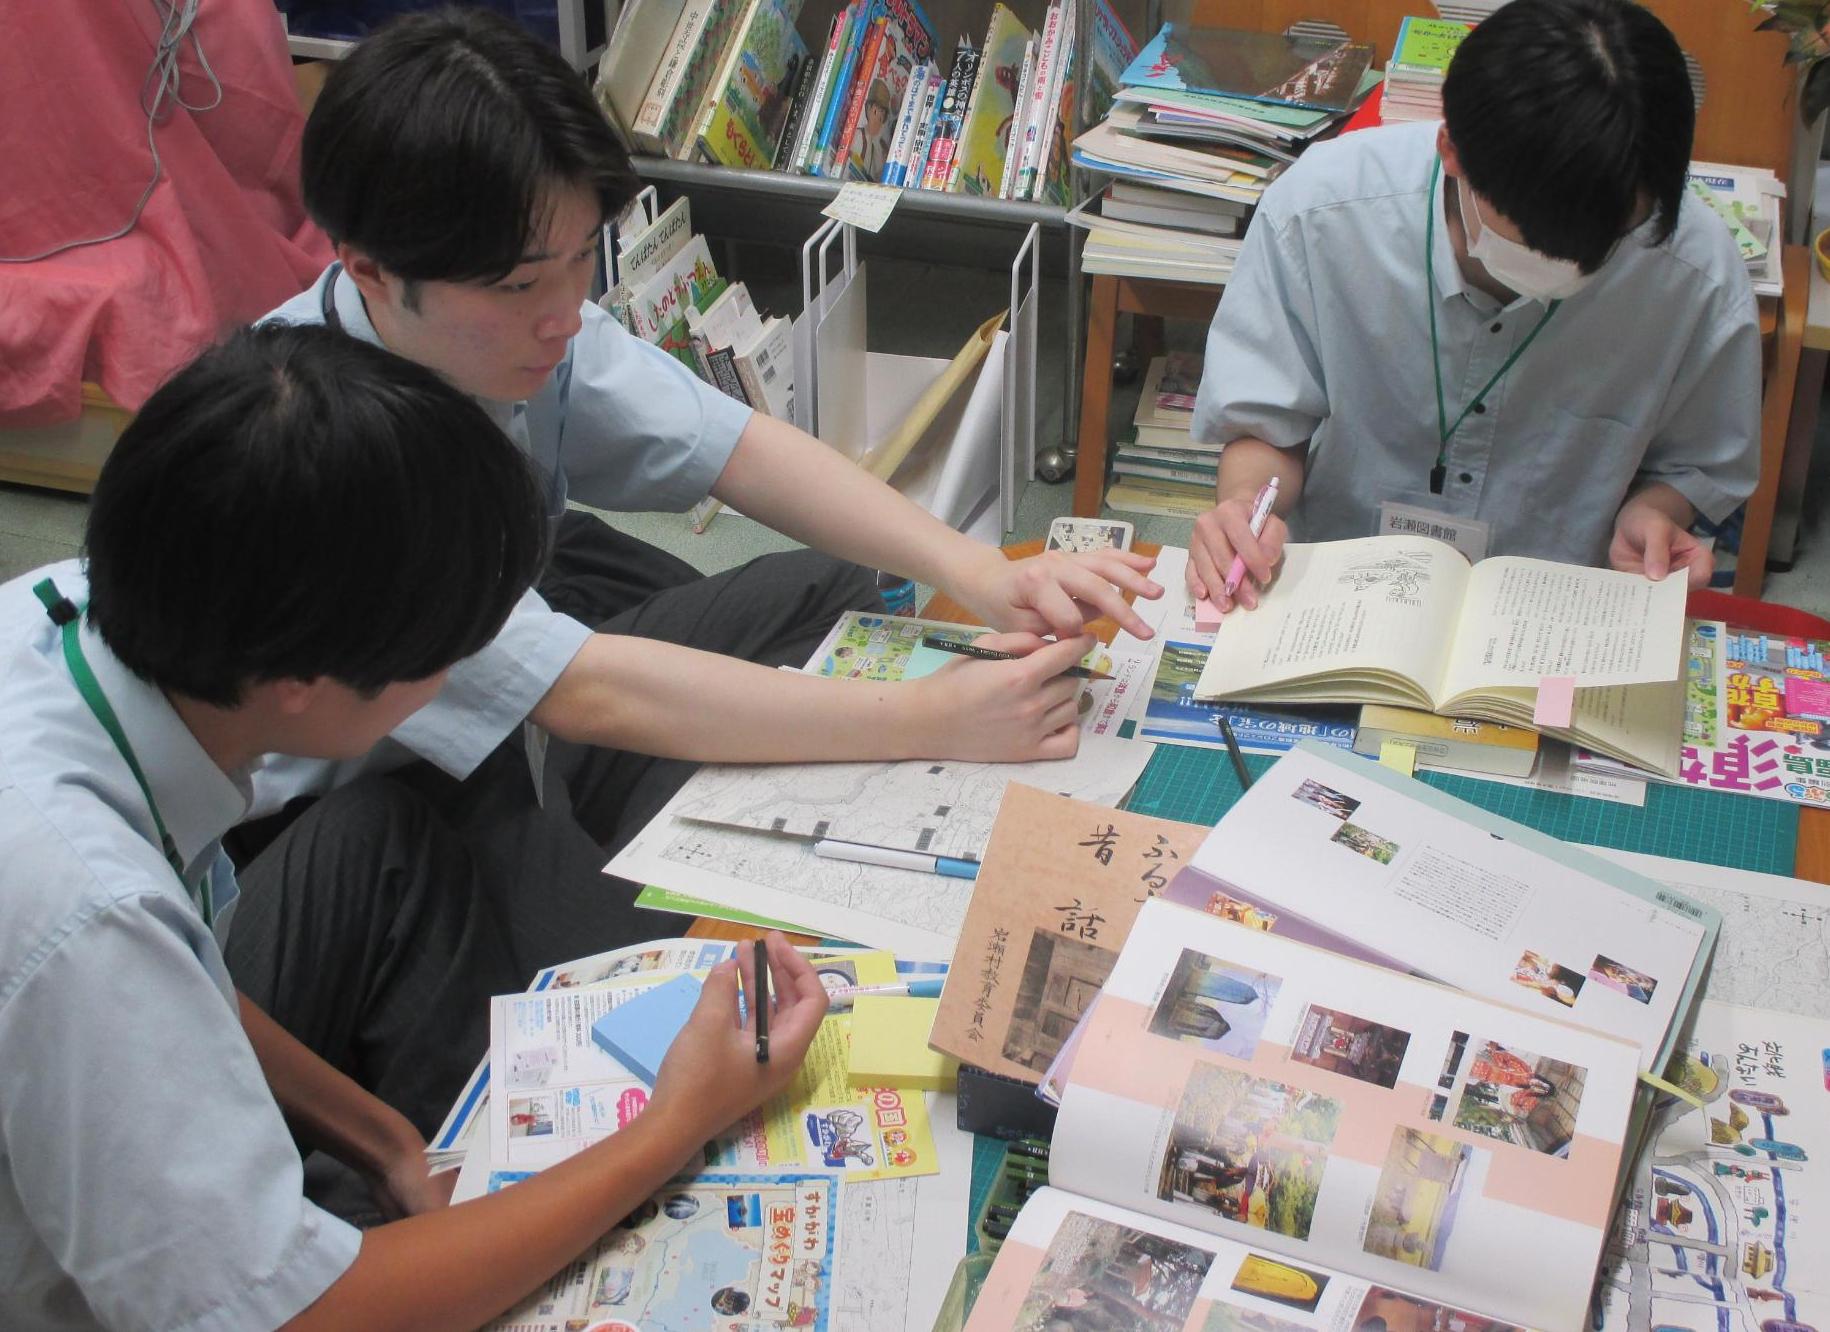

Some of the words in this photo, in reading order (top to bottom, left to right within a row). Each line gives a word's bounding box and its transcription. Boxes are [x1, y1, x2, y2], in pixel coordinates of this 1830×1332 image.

[1390, 515, 1457, 542] 岩瀬図書館
[1209, 713, 1355, 740] の「地域の宝」を
[961, 927, 1010, 1043] 岩瀬村教育委員会
[1737, 1043, 1758, 1087] あんない
[803, 1191, 821, 1251] すかがわ
[765, 1207, 795, 1311] 宝めぐりマップ
